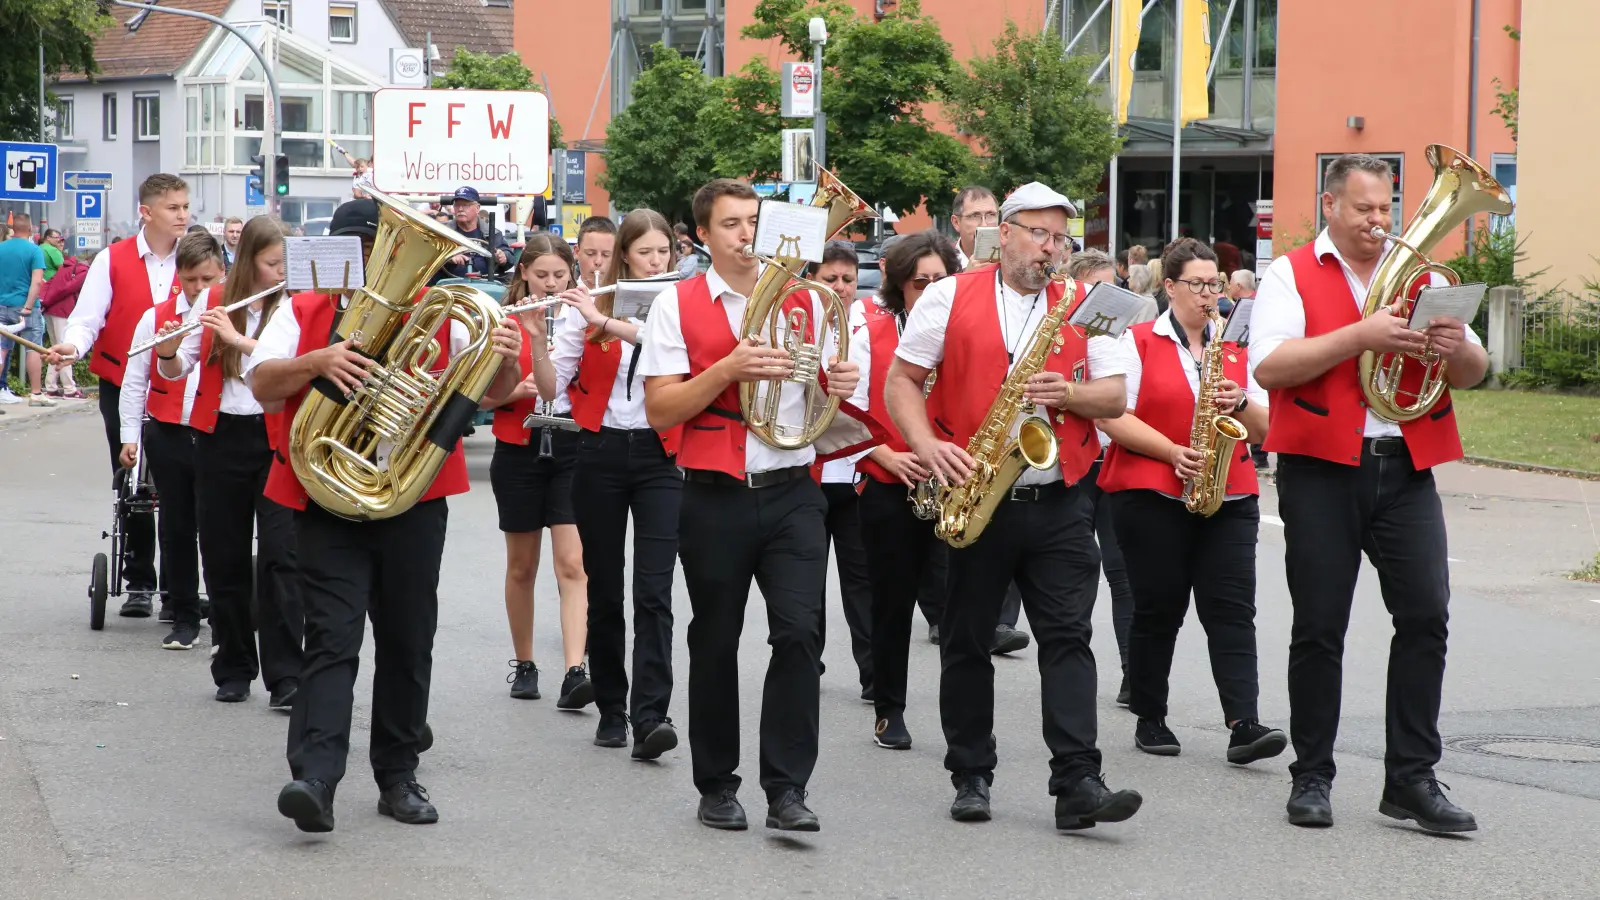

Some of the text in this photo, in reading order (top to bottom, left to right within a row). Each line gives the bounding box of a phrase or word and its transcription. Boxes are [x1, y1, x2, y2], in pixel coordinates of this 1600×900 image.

[408, 102, 515, 139] F F W
[403, 151, 520, 181] Wernsbach
[81, 195, 96, 216] P
